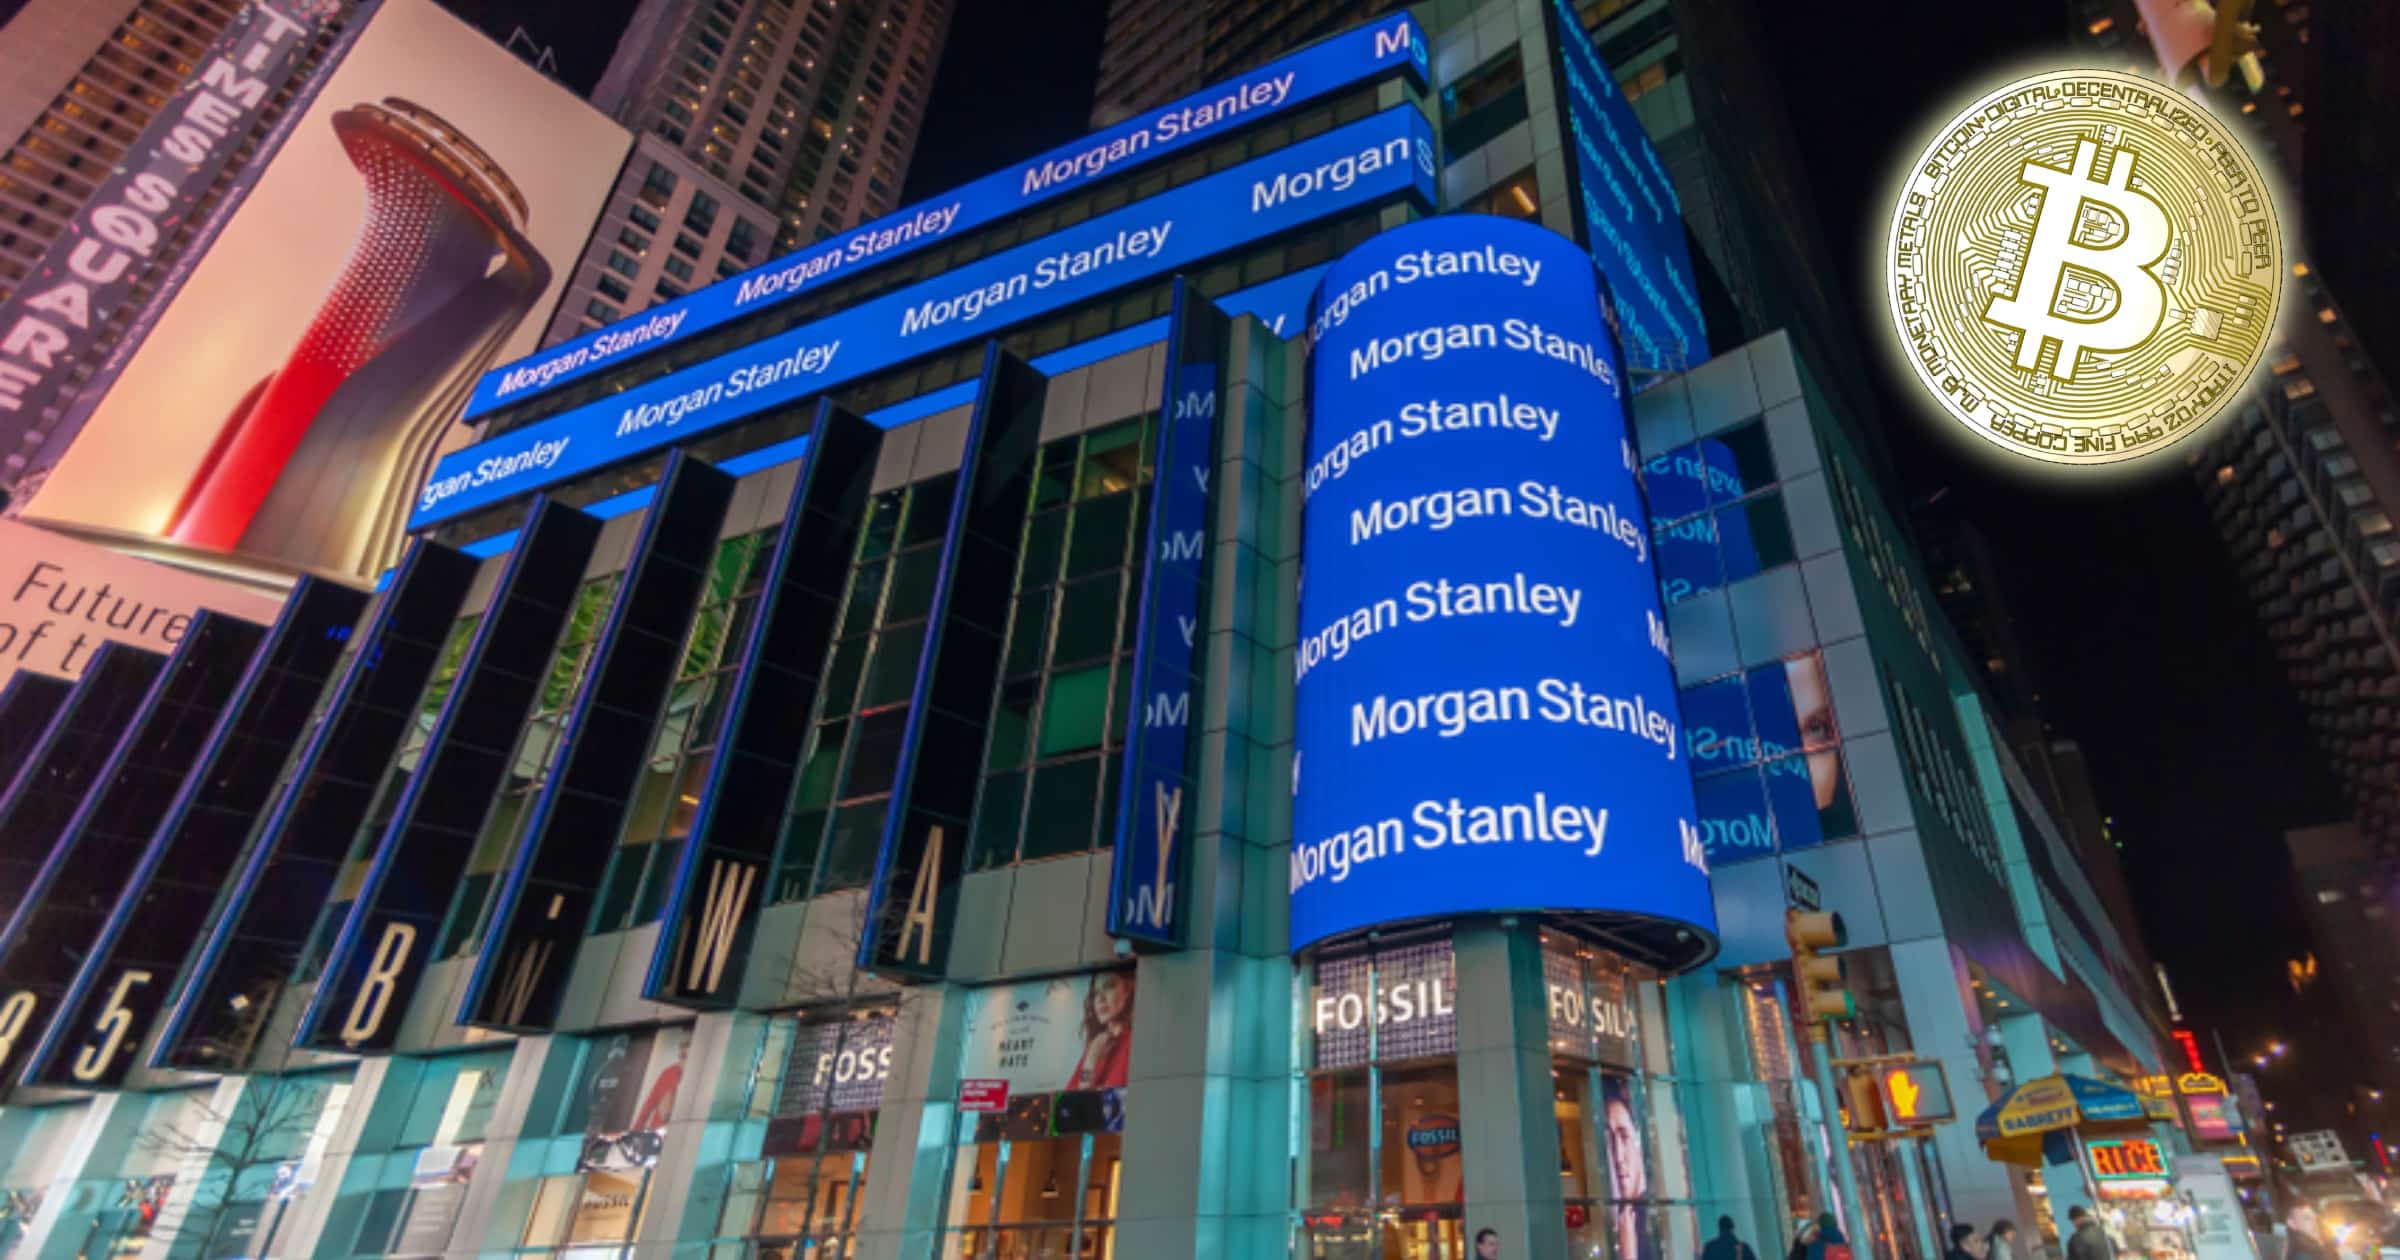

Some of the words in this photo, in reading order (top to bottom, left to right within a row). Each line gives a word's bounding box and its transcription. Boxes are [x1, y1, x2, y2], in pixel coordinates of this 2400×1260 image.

[162, 2, 307, 164] TIMES
[1022, 129, 1150, 195] Morgan
[1156, 71, 1295, 142] Stanley
[1251, 137, 1410, 212] Morgan
[736, 248, 842, 306] Morgan
[845, 203, 961, 262] Stanley
[900, 273, 1027, 337] Morgan
[1033, 221, 1172, 288] Stanley
[1395, 245, 1541, 286] Stanley
[496, 347, 589, 397] Morgan
[588, 308, 688, 361] Stanley
[615, 382, 724, 438] Morgan
[725, 340, 840, 398] Stanley
[1350, 318, 1498, 380] Morgan
[1503, 318, 1622, 398] Stanley
[1399, 393, 1560, 441] Stanley
[471, 436, 570, 487] Stanley
[1350, 482, 1513, 545] Morgan
[1518, 480, 1648, 563] Stanley
[13, 562, 193, 644] Future
[1405, 572, 1582, 627] Stanley
[1351, 686, 1531, 746] Morgan
[1536, 677, 1676, 761] Stanley
[1411, 791, 1609, 857] Stanley
[340, 922, 417, 1042] B
[895, 825, 944, 965] A
[73, 970, 152, 1080] 5
[2092, 1140, 2165, 1174] RICE
